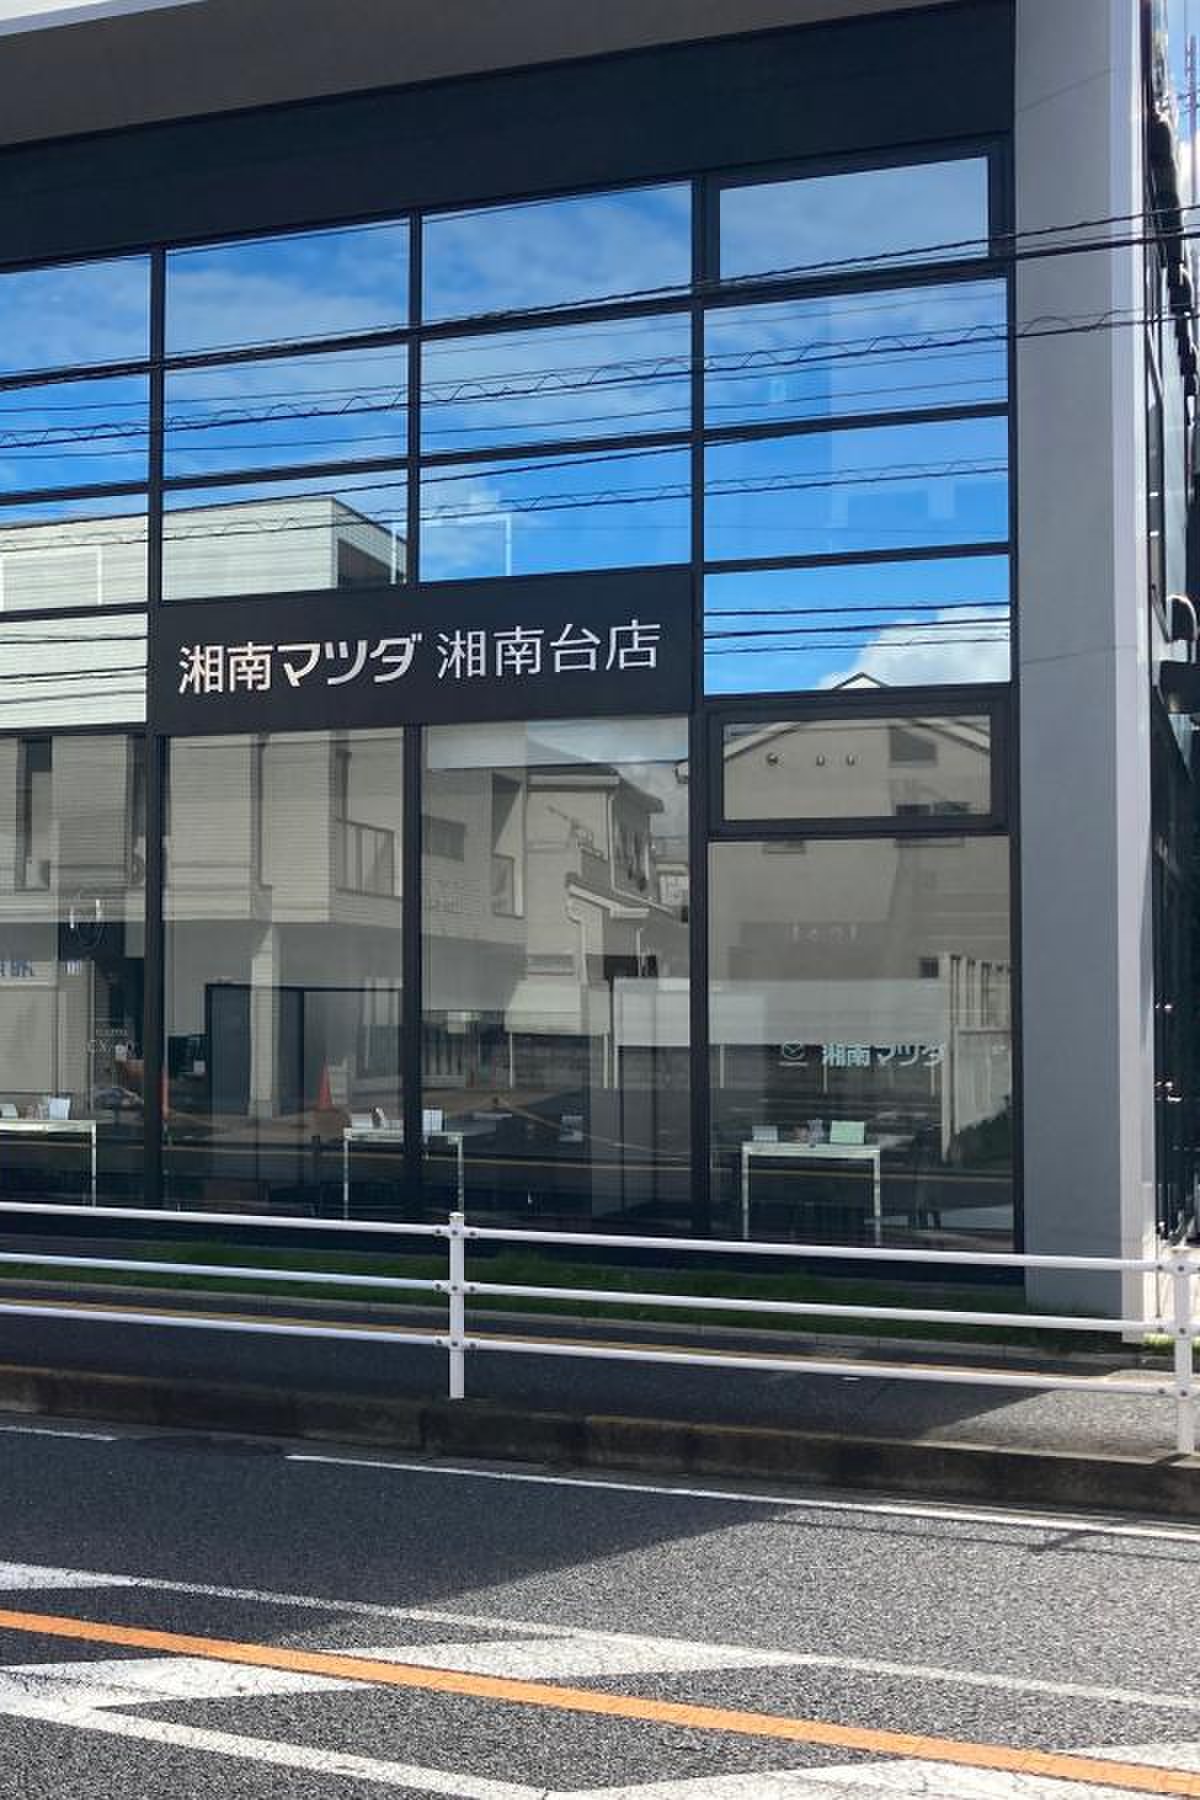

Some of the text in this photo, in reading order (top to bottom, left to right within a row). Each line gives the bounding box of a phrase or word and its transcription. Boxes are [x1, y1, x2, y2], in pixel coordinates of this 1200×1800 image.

[178, 618, 661, 695] 湘南マツダ 湘南台店
